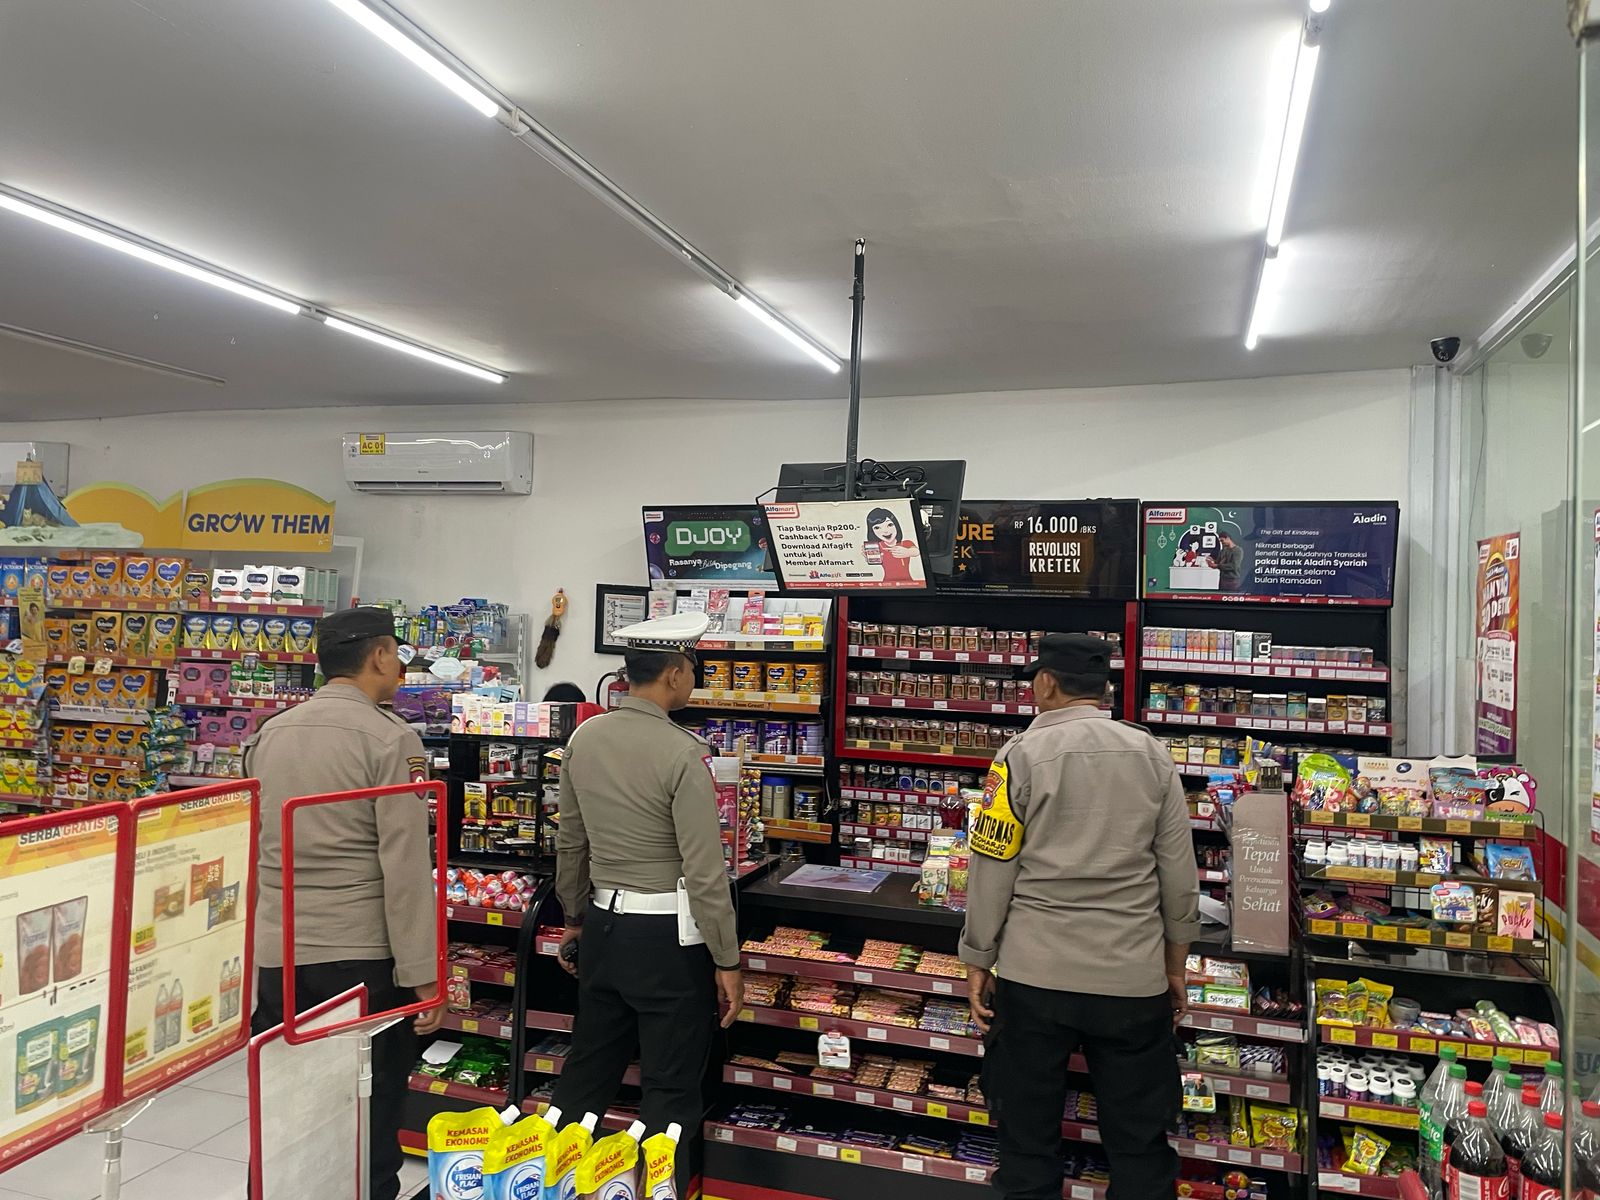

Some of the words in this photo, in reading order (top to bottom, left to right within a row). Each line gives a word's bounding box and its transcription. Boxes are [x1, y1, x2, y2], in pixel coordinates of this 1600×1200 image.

[188, 511, 265, 533] GROW
[271, 515, 330, 534] THEM
[1014, 521, 1024, 529] RP
[1027, 516, 1078, 533] 16.000
[1352, 513, 1387, 524] Aladin
[795, 524, 826, 532] Belanja
[675, 527, 742, 544] DJOY
[1029, 542, 1080, 557] REVOLUSI
[1282, 543, 1314, 551] berbagai
[1295, 551, 1333, 559] Mudahnya
[669, 559, 702, 567] Rasanya
[714, 562, 752, 571] Dipegang
[1029, 558, 1081, 572] KRETEK
[1254, 558, 1279, 567] pakai
[1333, 559, 1367, 568] Syariah
[1264, 567, 1302, 575] Alfamart
[1303, 568, 1336, 576] selama
[1280, 577, 1322, 585] Ramadan
[181, 798, 210, 811] SERBA
[212, 792, 241, 804] GRATIS
[19, 829, 61, 845] SERBA
[63, 818, 105, 835] GRATIS
[1242, 846, 1281, 865] Tepat
[1249, 865, 1273, 874] Untuk
[1239, 874, 1284, 885] Perencanaan
[1245, 885, 1277, 896] Keluarga
[1242, 896, 1282, 913] Sehat
[447, 1127, 489, 1137] KEMASAN
[445, 1137, 490, 1146] EKONOMIS
[506, 1134, 539, 1153] KEMASAN
[504, 1144, 543, 1164] EKONOMIS
[556, 1143, 578, 1165] KEMASAN
[555, 1151, 582, 1177] EKONOMIS
[594, 1150, 622, 1172] KEMASAN
[455, 1173, 482, 1181] FRISIAN
[594, 1159, 625, 1183] EKONOMIS
[459, 1180, 477, 1188] FLAG
[516, 1181, 540, 1196] FRISIAN
[520, 1189, 536, 1200] FLAG
